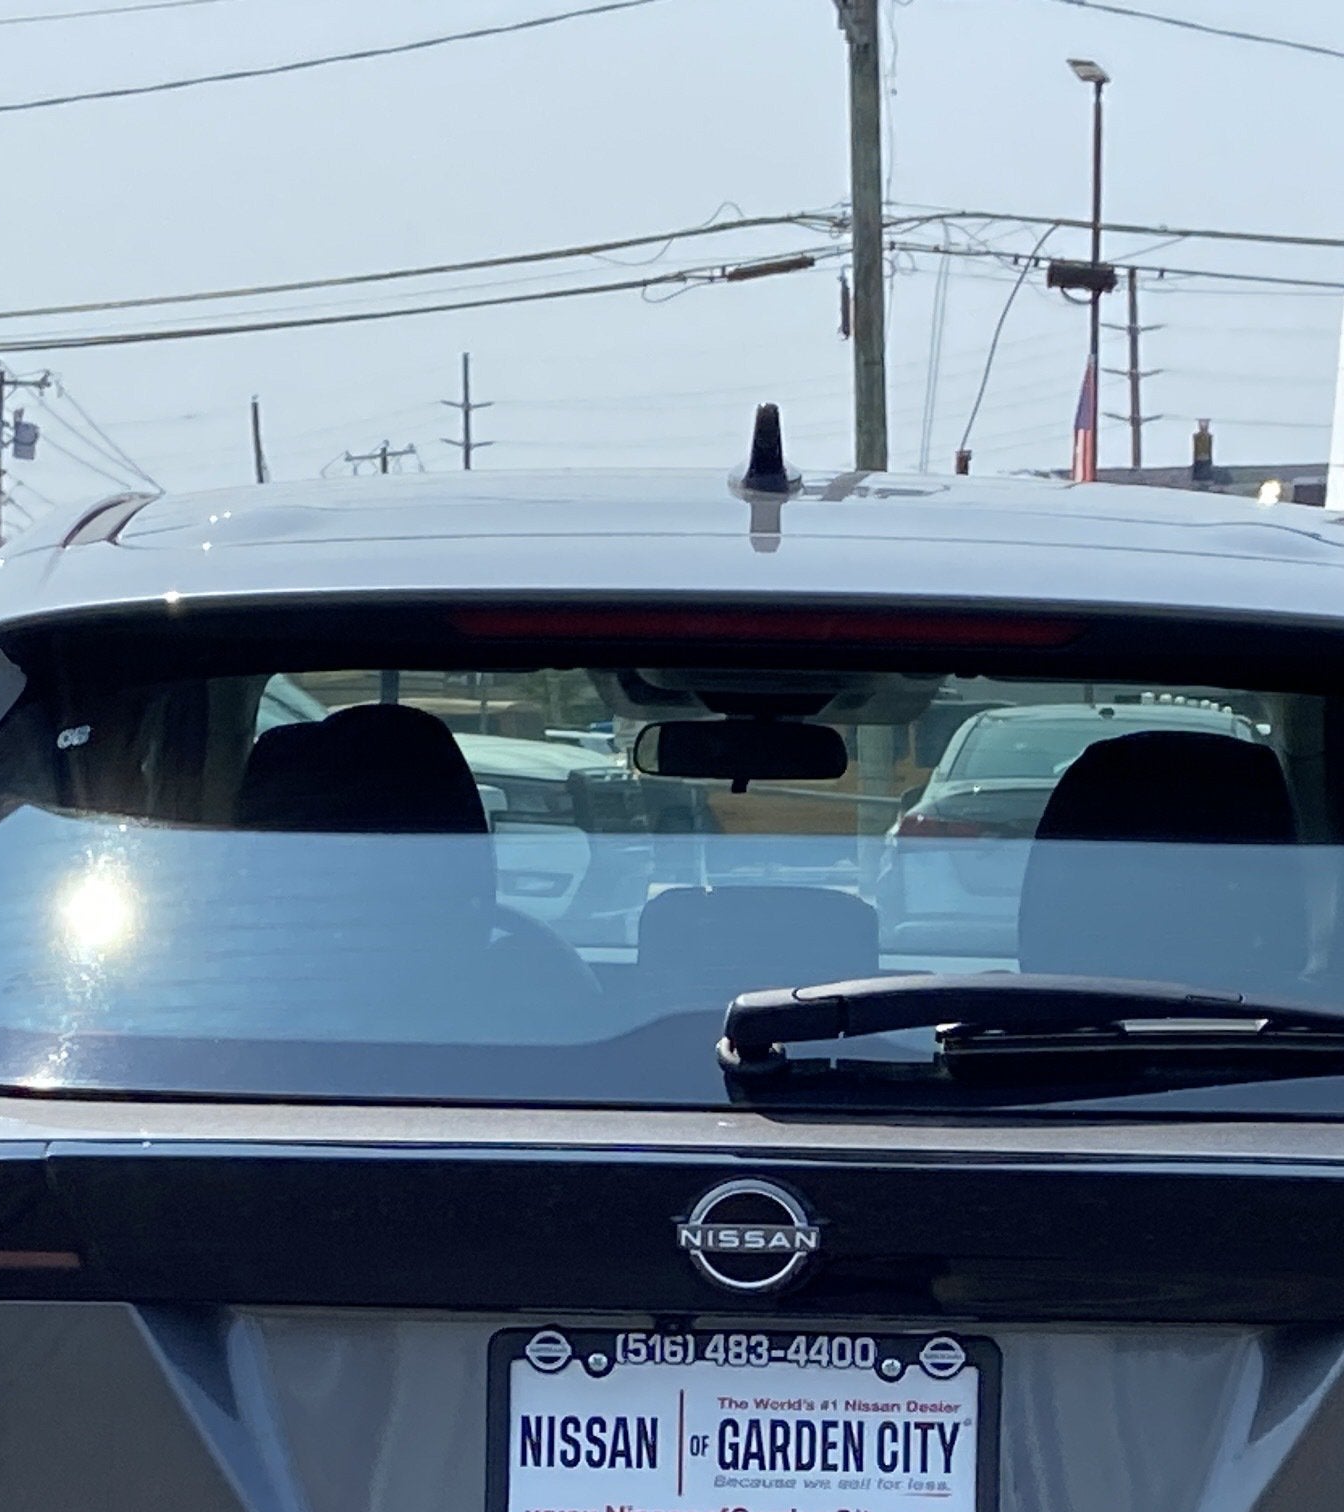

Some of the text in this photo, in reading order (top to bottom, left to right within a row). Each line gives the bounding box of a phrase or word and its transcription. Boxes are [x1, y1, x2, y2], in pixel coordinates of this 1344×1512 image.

[680, 1229, 817, 1249] NISSAN
[616, 1333, 877, 1369] (516) 483-4400
[717, 1396, 748, 1410] The
[753, 1397, 815, 1411] World's
[844, 1399, 901, 1413] Nissan
[906, 1399, 962, 1414] Dealer
[519, 1415, 962, 1474] NISSAN OF GARDEN CITY
